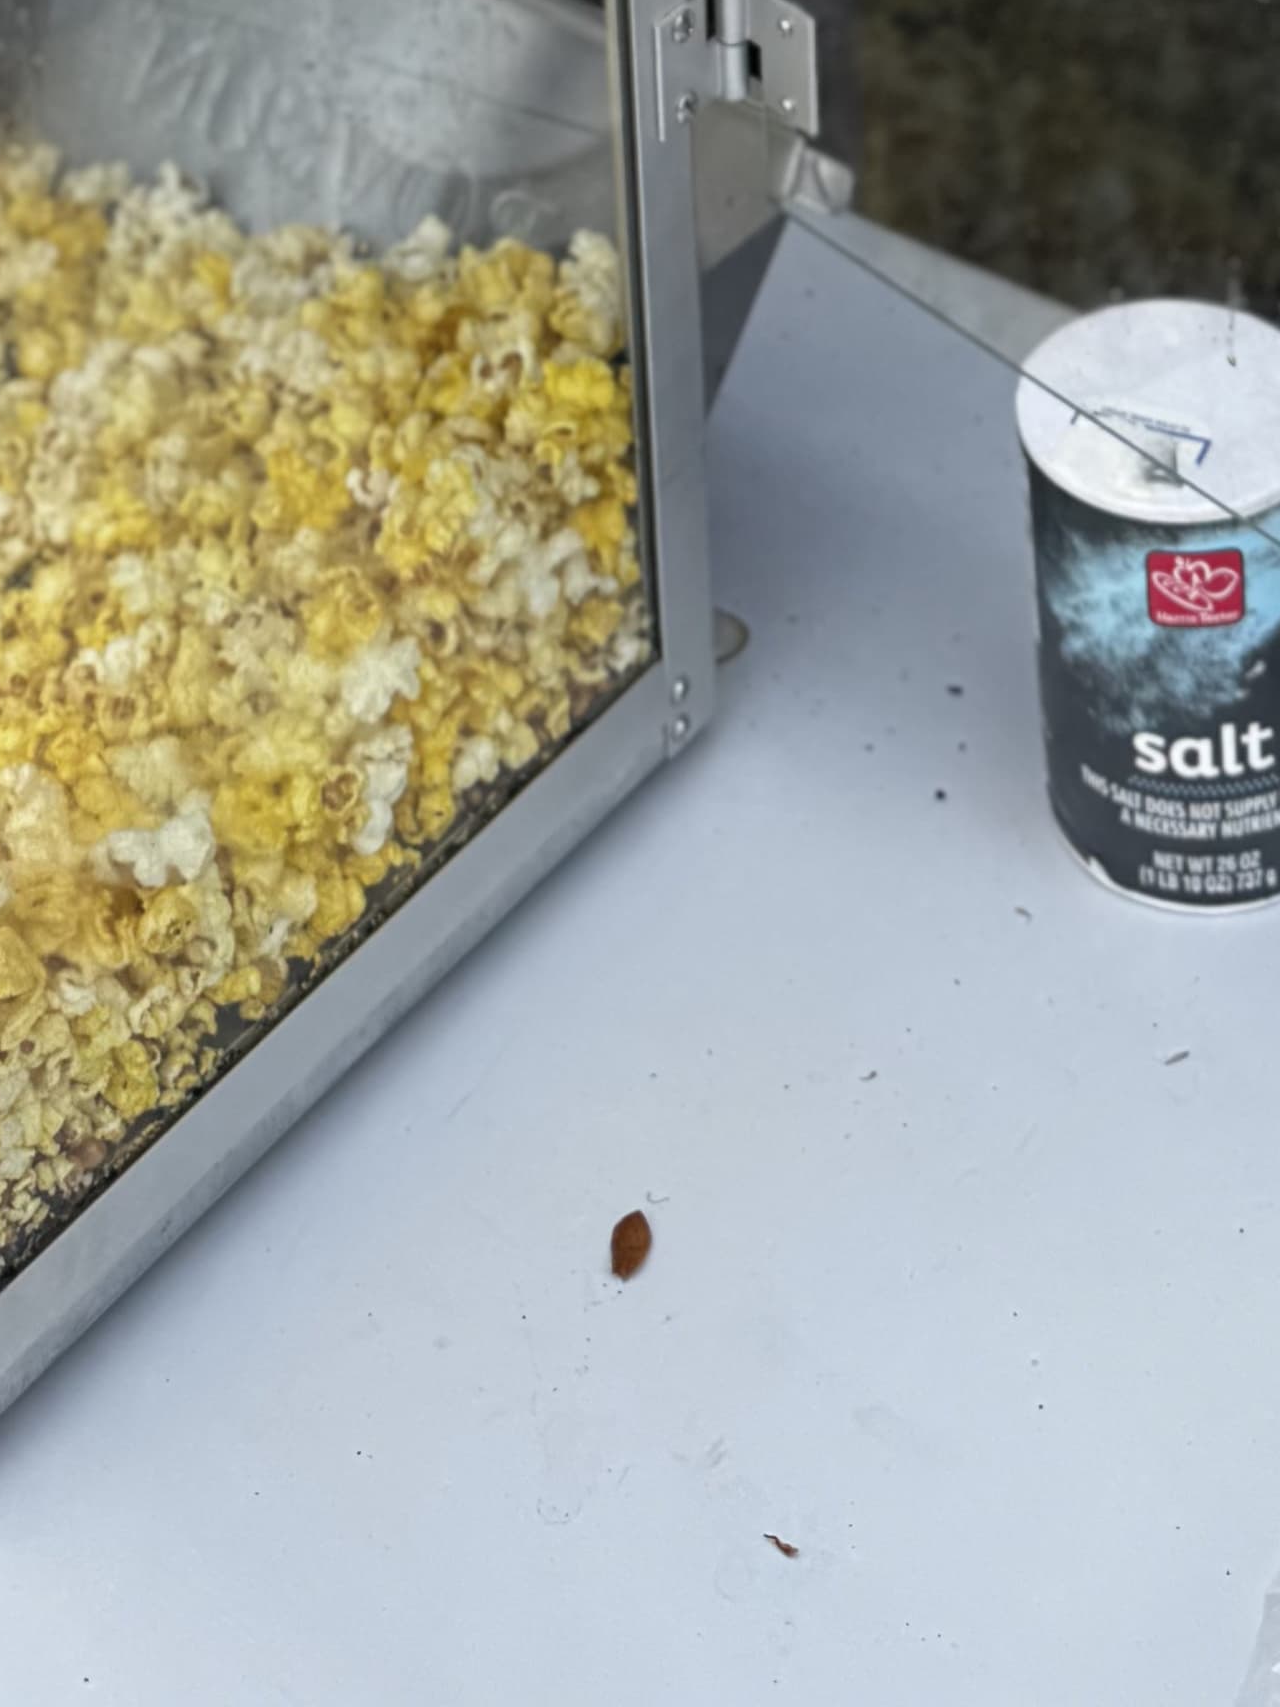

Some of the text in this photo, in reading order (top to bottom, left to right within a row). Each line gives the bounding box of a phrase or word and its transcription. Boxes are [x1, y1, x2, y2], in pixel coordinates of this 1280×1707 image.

[1133, 721, 1275, 779] salt
[1189, 803, 1221, 819] NOT
[1224, 791, 1277, 817] SUPPLY
[1121, 807, 1131, 826] A
[1135, 812, 1217, 839] NECESSARY
[1153, 849, 1261, 874] NET WT 26 OZ
[1157, 870, 1179, 890] LB
[1237, 868, 1263, 891] 737
